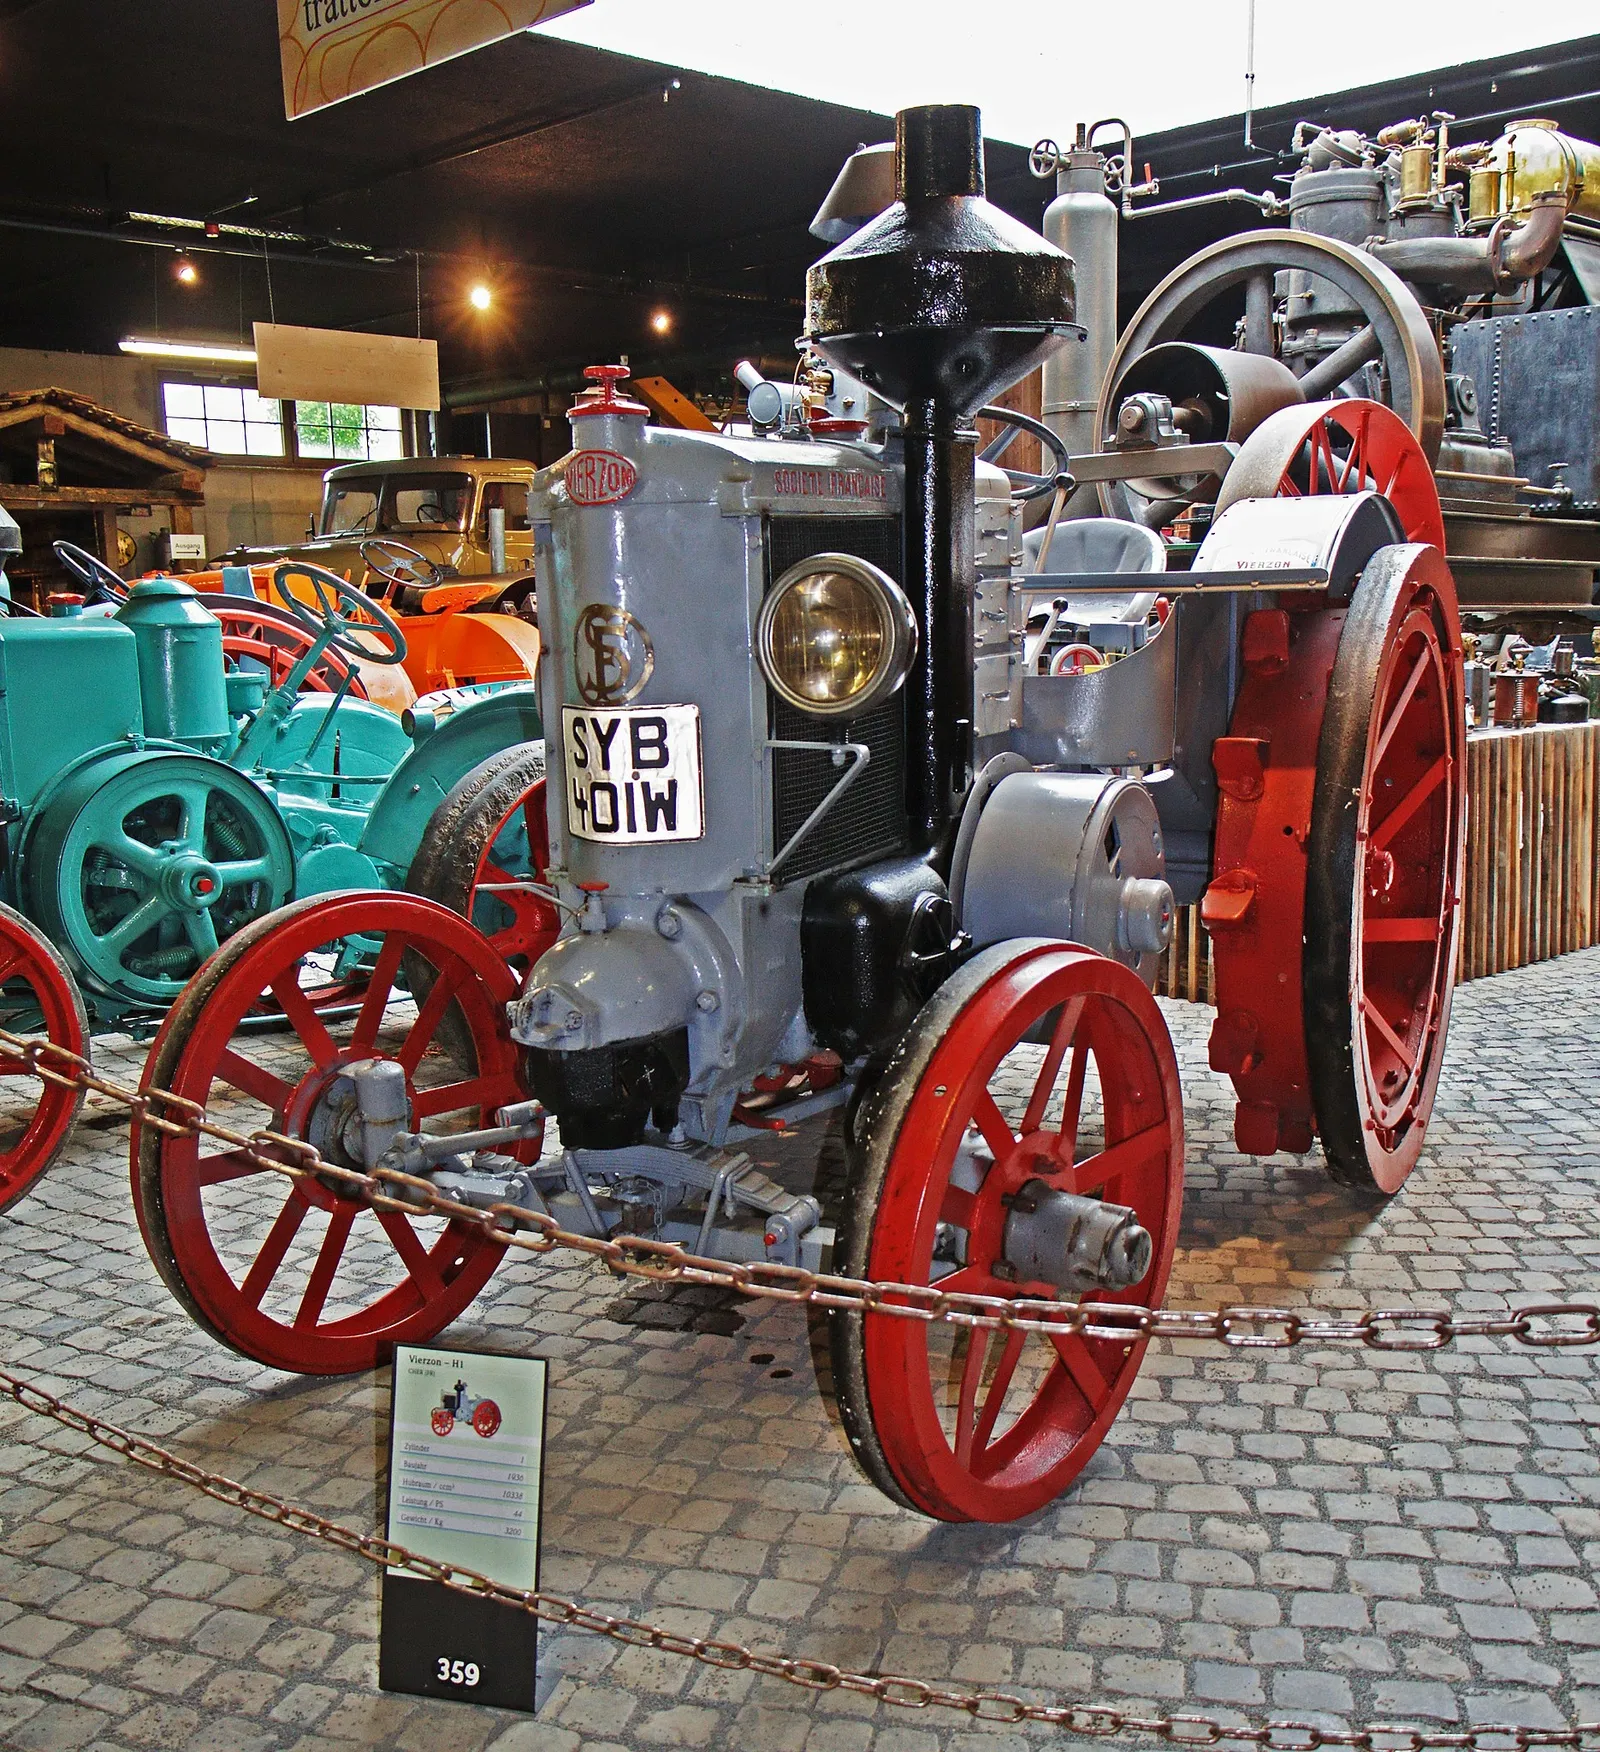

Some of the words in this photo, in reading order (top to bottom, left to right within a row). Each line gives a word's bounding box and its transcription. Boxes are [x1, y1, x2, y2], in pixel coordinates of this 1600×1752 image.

[175, 542, 201, 550] Ausgang
[1236, 560, 1291, 570] VIERZON
[572, 716, 670, 771] SYB
[409, 1354, 442, 1366] Vierzon
[452, 1359, 464, 1368] H1
[404, 1442, 430, 1453] Zylinder
[403, 1460, 427, 1470] Baujahr
[402, 1478, 432, 1489] Hubraum
[401, 1495, 428, 1507] Leistung
[435, 1499, 444, 1508] PS
[513, 1509, 522, 1517] 44
[400, 1513, 427, 1524] Gewicht
[504, 1526, 522, 1536] 3200
[437, 1657, 480, 1686] 359
